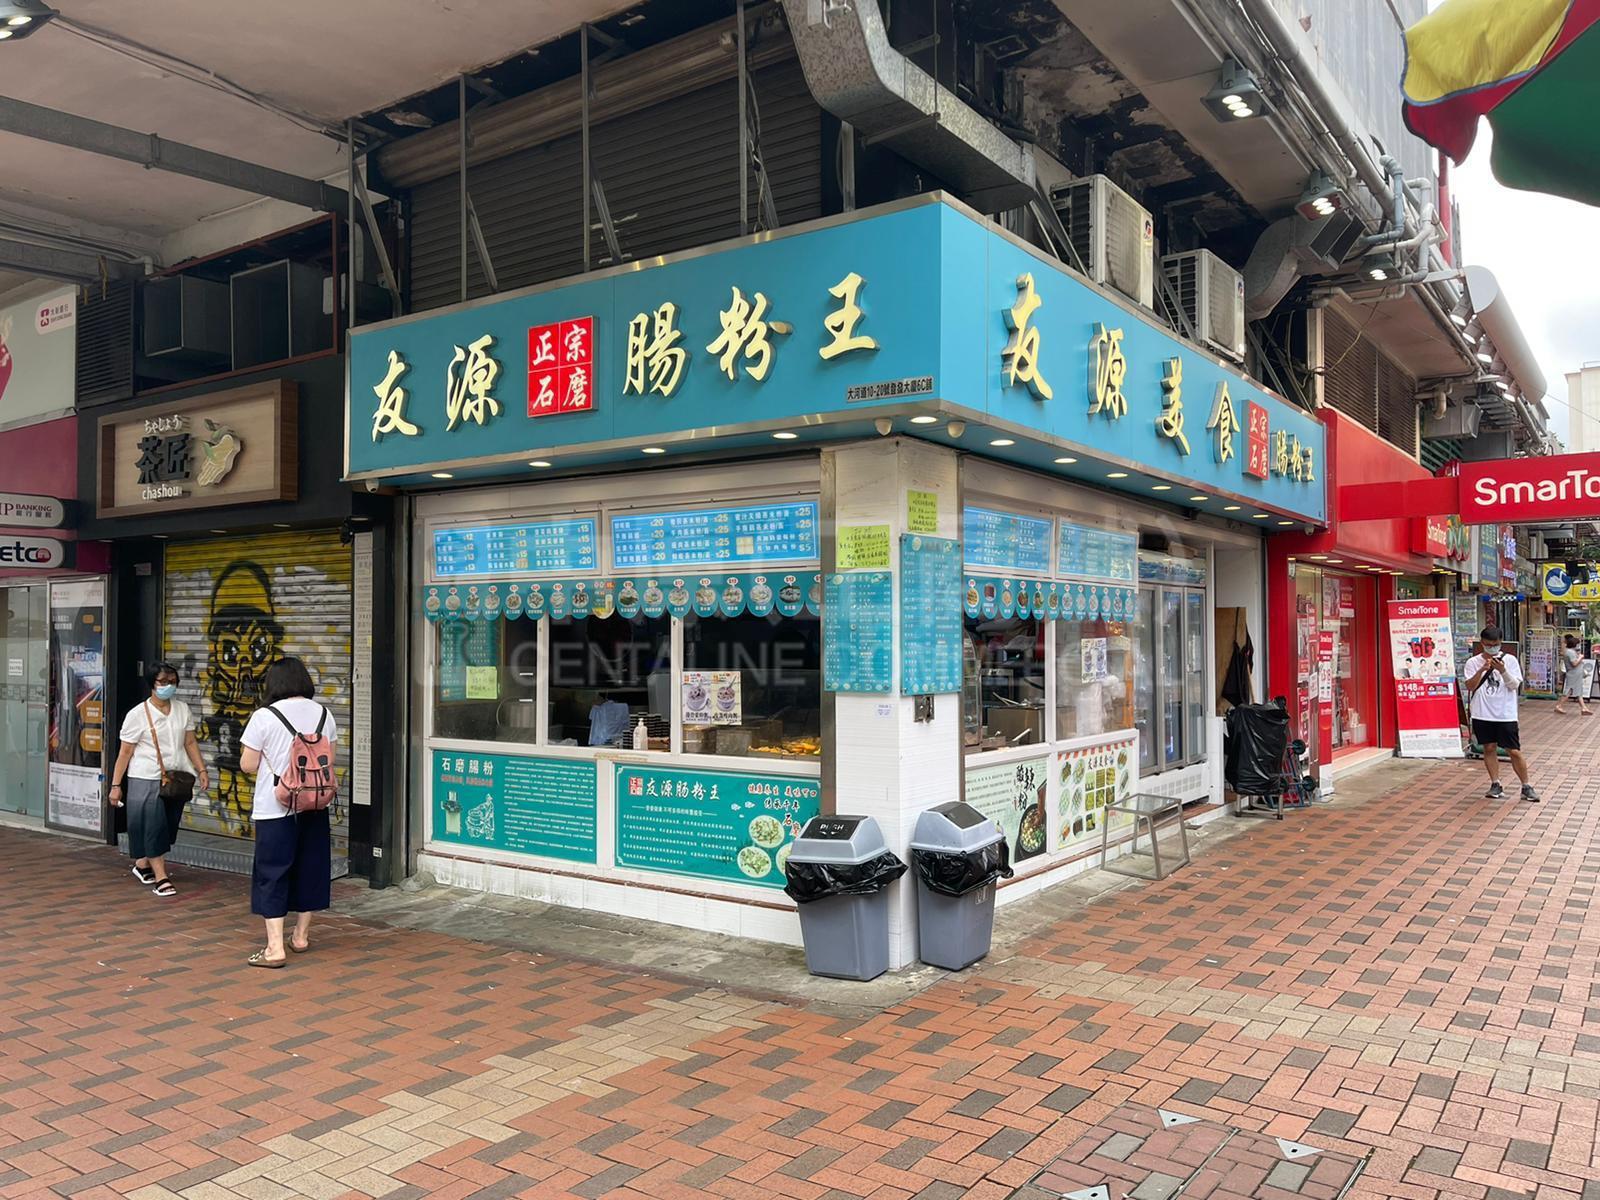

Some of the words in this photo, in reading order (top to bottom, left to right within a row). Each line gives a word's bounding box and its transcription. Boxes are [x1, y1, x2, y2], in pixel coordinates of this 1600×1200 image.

[372, 334, 500, 443] 友源
[622, 271, 879, 396] 腸粉王
[1002, 272, 1240, 464] 友源美食
[532, 371, 588, 413] 石磨
[135, 433, 191, 484] 茶匠
[16, 503, 52, 512] BANKING
[142, 483, 182, 500] chashou
[1398, 605, 1439, 616] SmarTone
